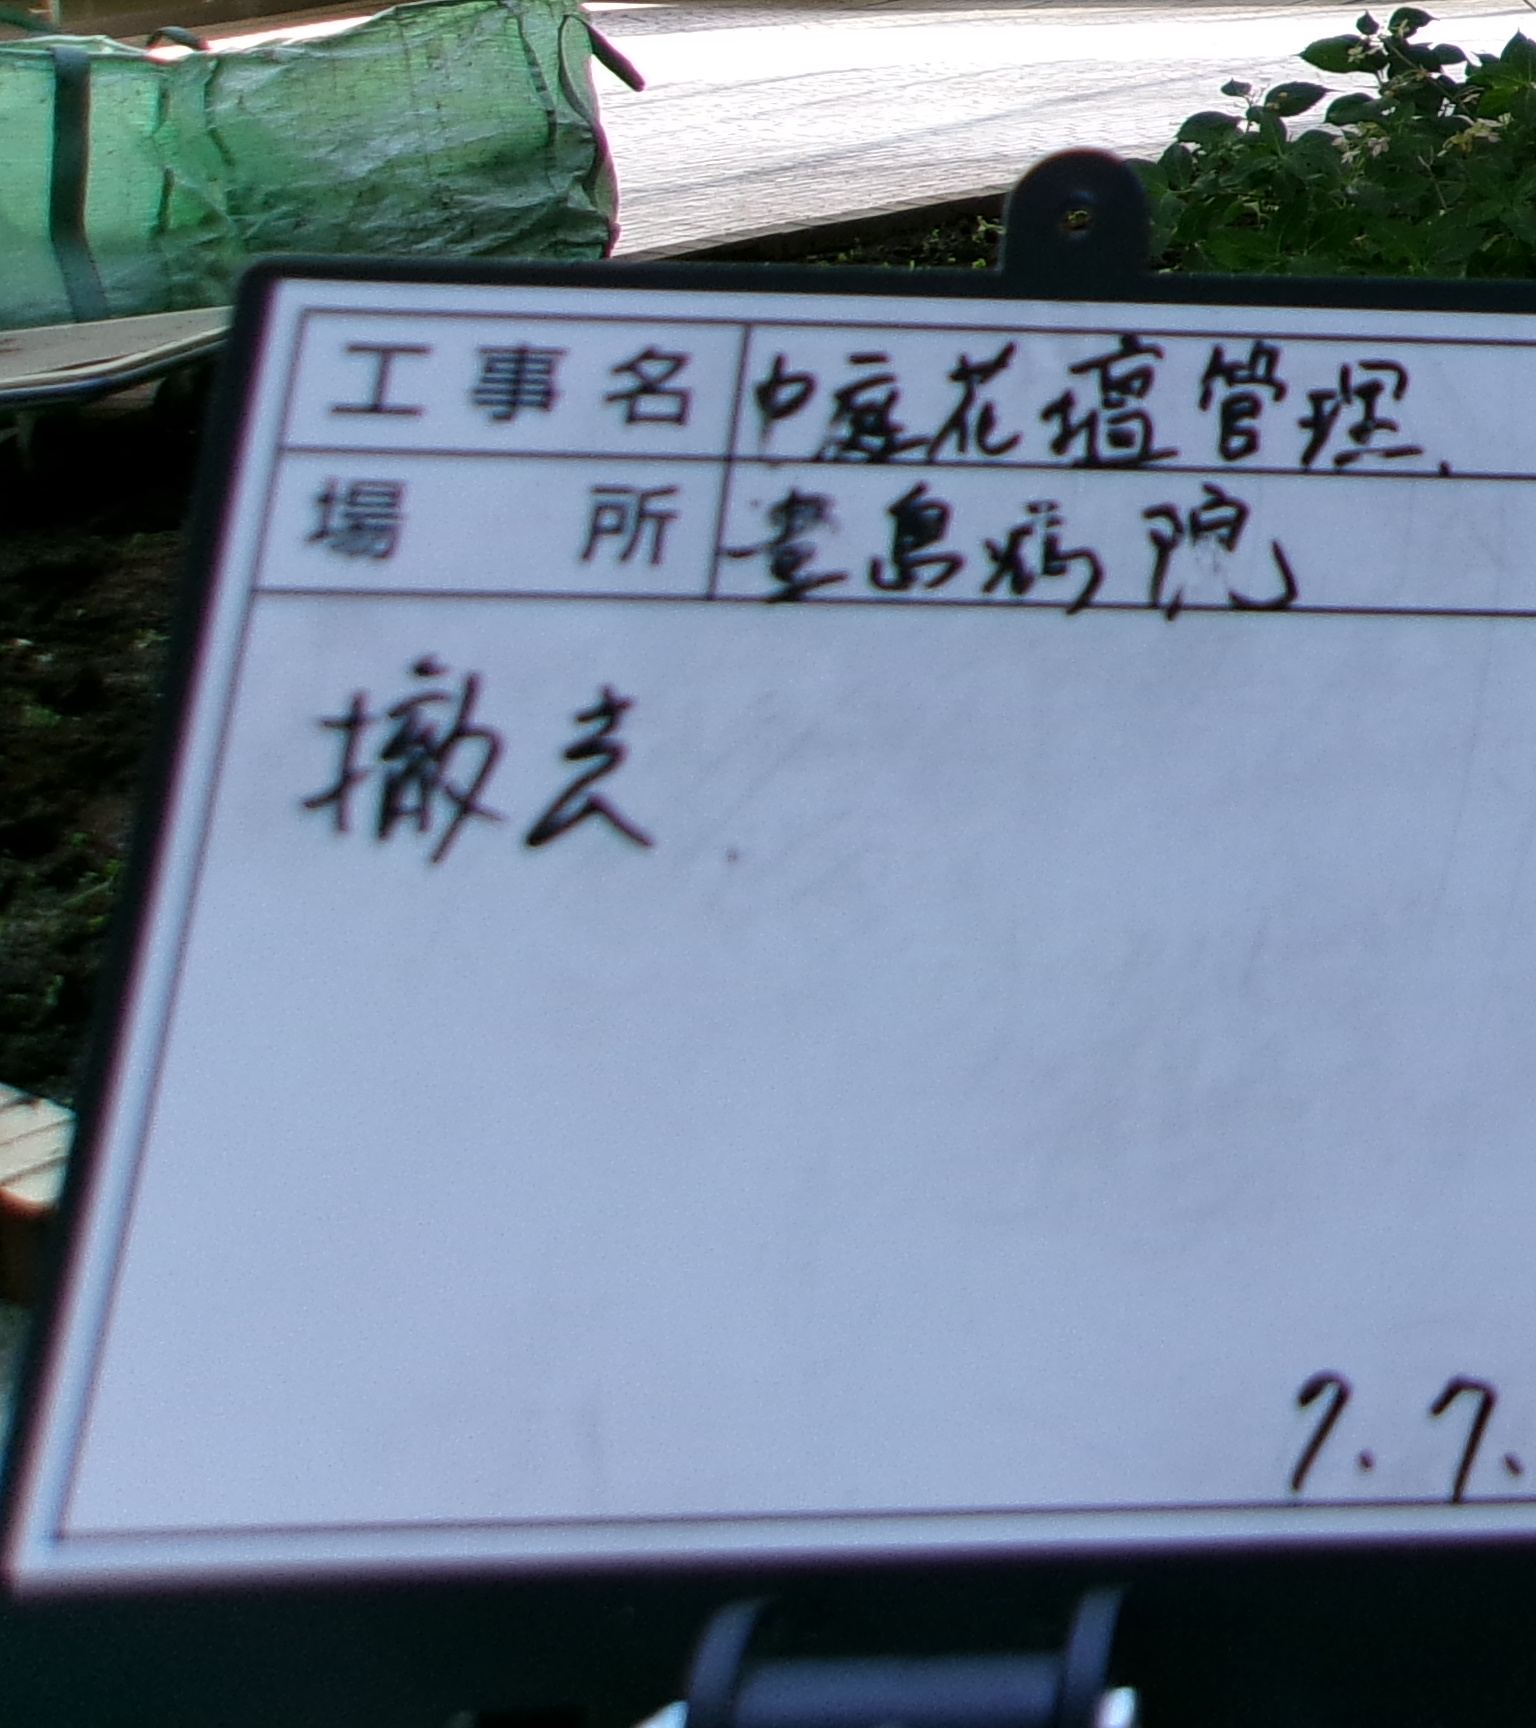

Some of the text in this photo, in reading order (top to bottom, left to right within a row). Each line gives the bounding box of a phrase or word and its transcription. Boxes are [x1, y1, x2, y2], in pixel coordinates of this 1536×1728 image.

[330, 341, 694, 427] 工事名
[306, 478, 682, 566] 場所
[302, 654, 656, 866] 撤去
